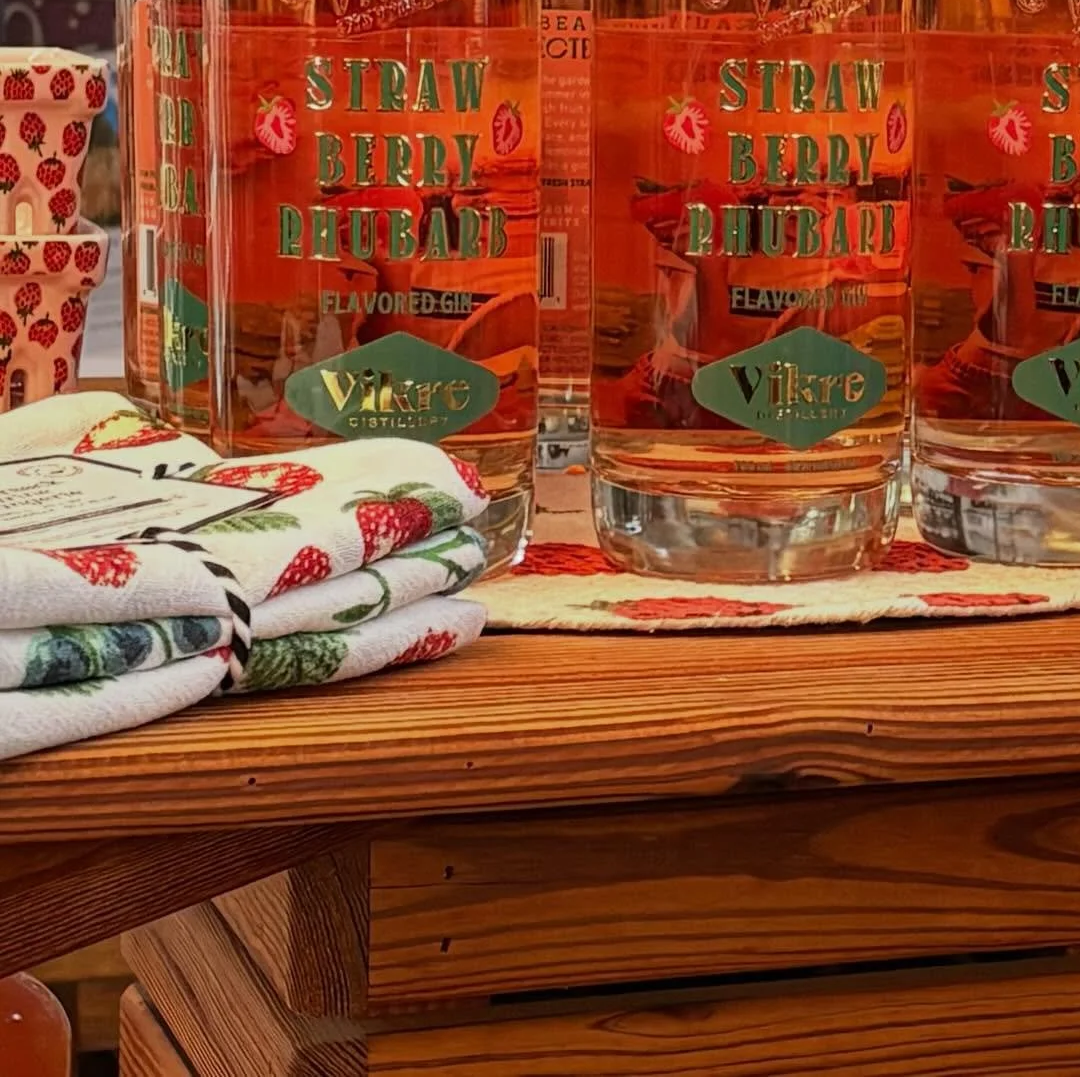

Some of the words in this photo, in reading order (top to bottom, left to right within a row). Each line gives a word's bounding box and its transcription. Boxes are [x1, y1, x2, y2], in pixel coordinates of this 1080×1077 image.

[303, 55, 490, 112] STRAW
[719, 58, 885, 113] STRAW
[314, 130, 482, 188] BERRY
[727, 131, 880, 187] BERRY
[277, 203, 508, 262] RHUBARB
[684, 201, 899, 259] RHUBARB
[321, 290, 435, 317] FLAVORED
[439, 291, 474, 315] GIN
[320, 368, 470, 414] Vikre
[729, 360, 866, 407] Vikre
[348, 415, 450, 429] DISTILLERY
